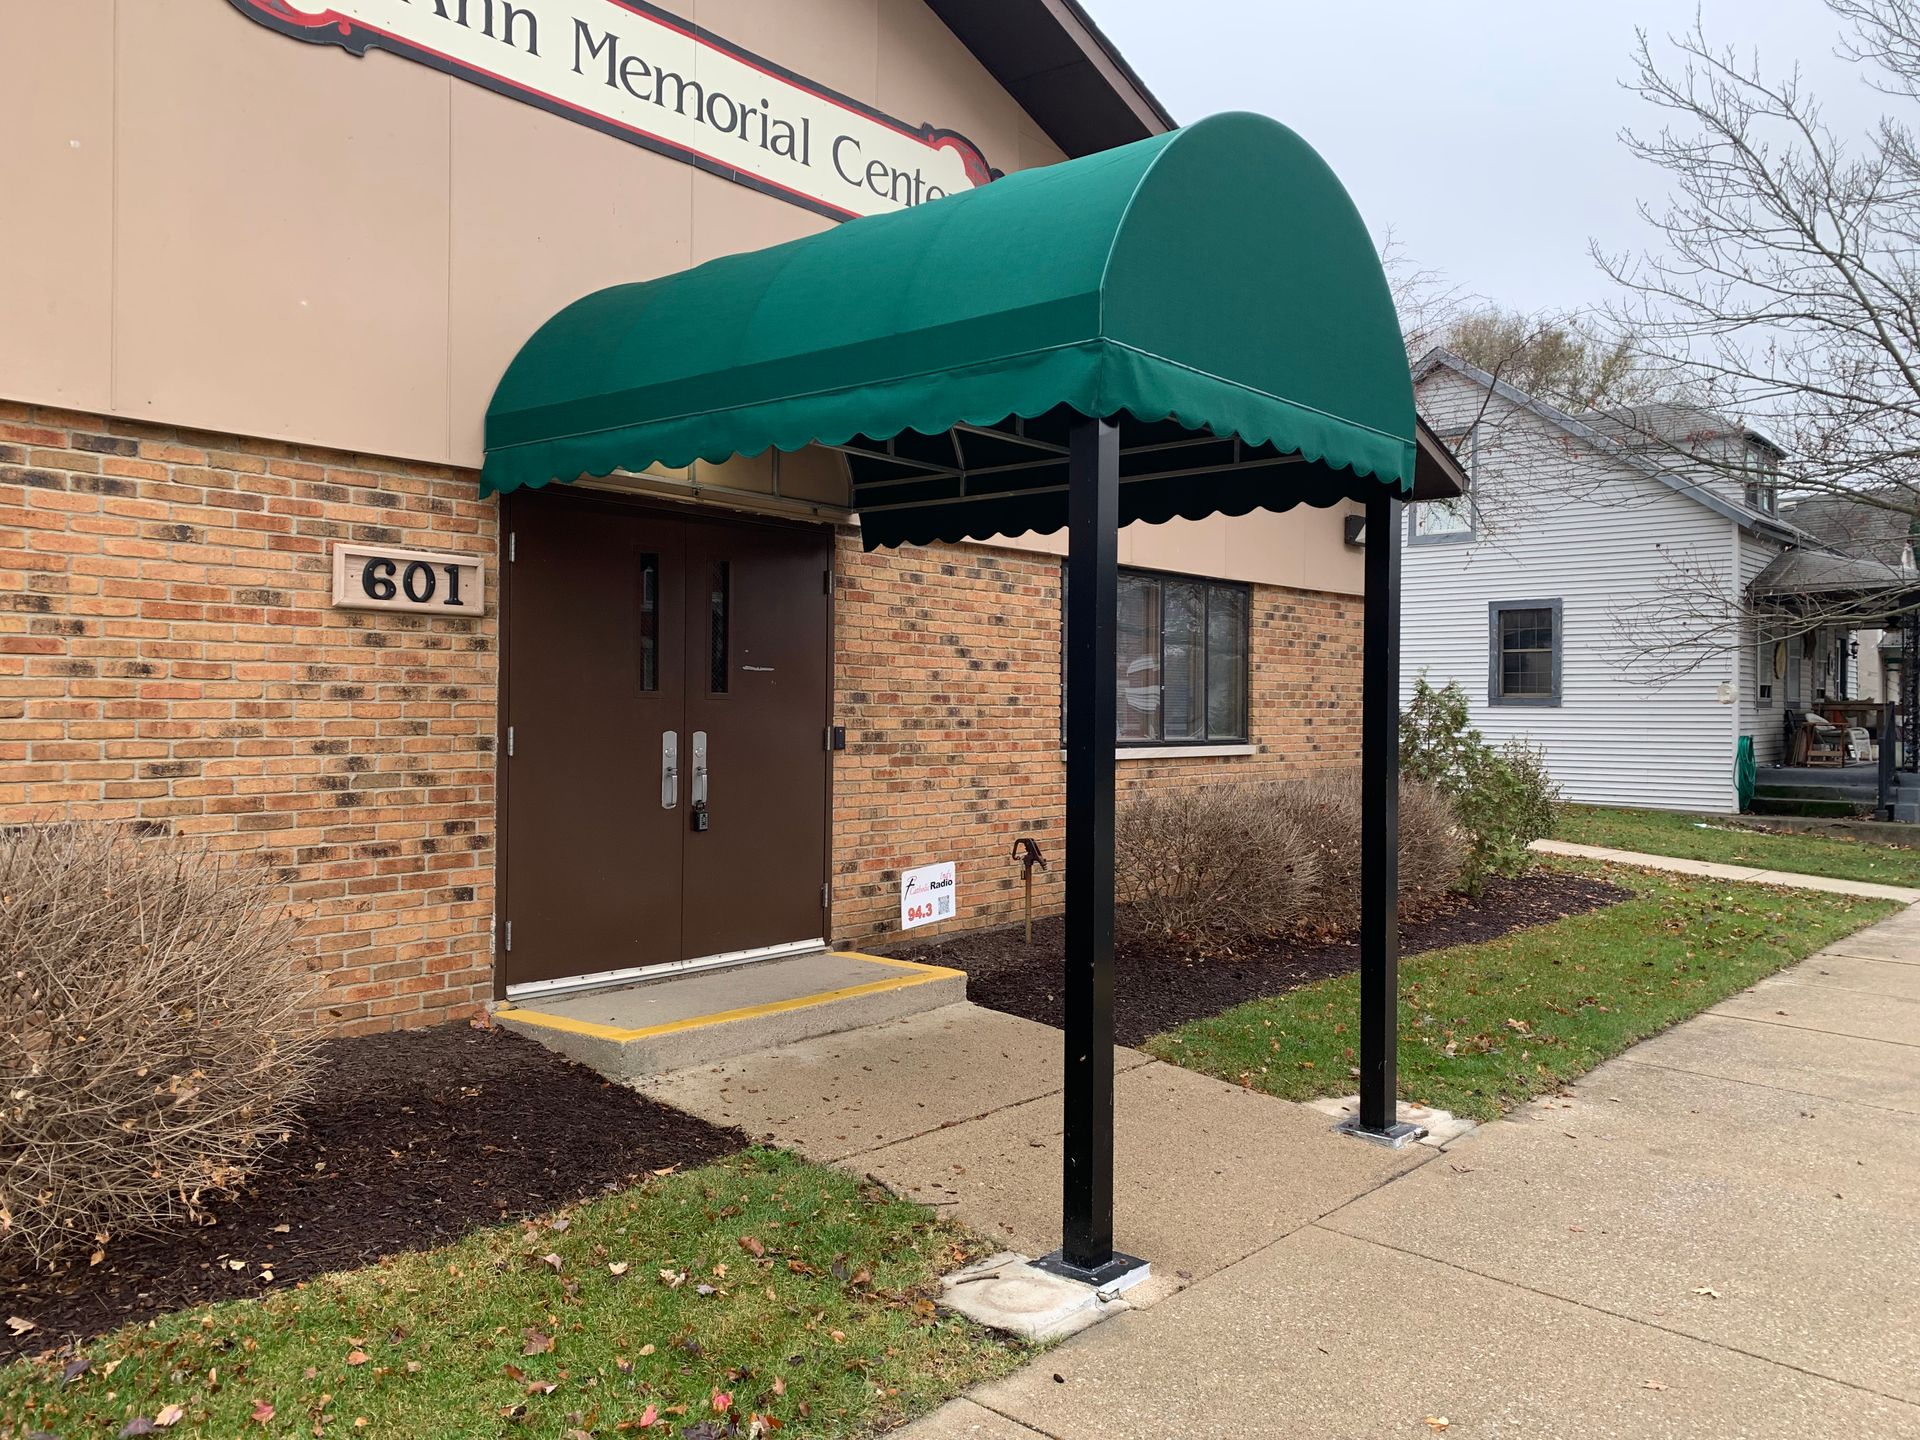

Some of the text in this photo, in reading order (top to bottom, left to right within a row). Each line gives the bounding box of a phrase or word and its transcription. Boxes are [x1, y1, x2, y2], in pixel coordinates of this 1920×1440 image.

[571, 16, 811, 167] Memorial
[362, 558, 464, 605] 601
[930, 879, 953, 890] Radio
[908, 903, 932, 921] 94.3
